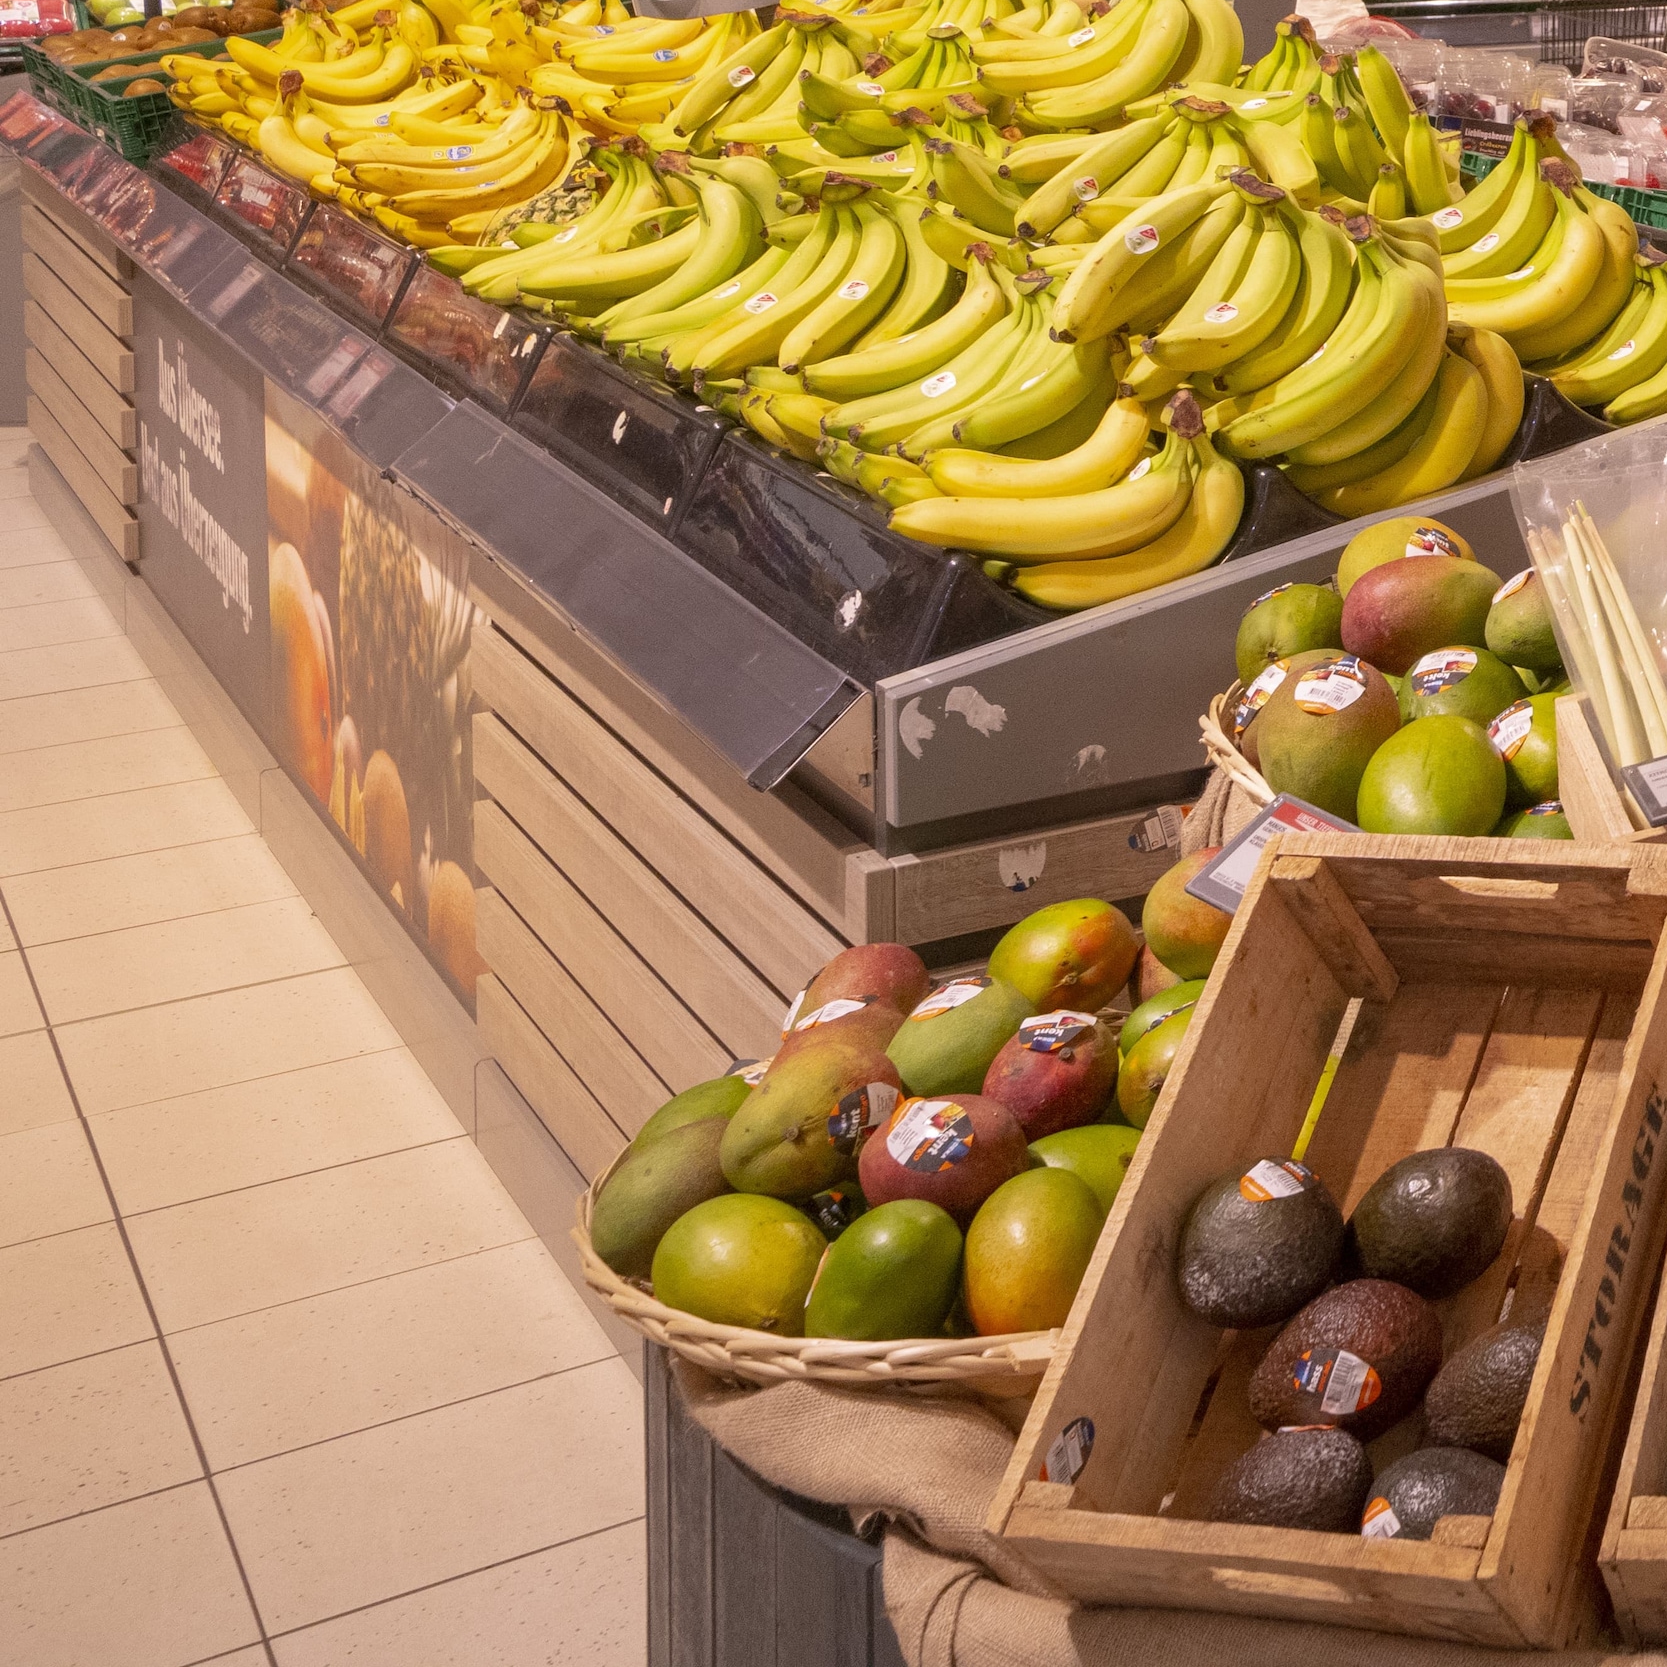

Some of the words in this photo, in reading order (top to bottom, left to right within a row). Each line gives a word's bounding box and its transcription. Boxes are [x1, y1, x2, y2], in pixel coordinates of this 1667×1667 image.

[158, 336, 177, 424] Aus
[177, 338, 225, 475] Übersee.
[1297, 812, 1316, 827] UNSER
[928, 1128, 959, 1157] kent
[1569, 1082, 1667, 1424] STORAGE
[1306, 1364, 1324, 1394] hass
